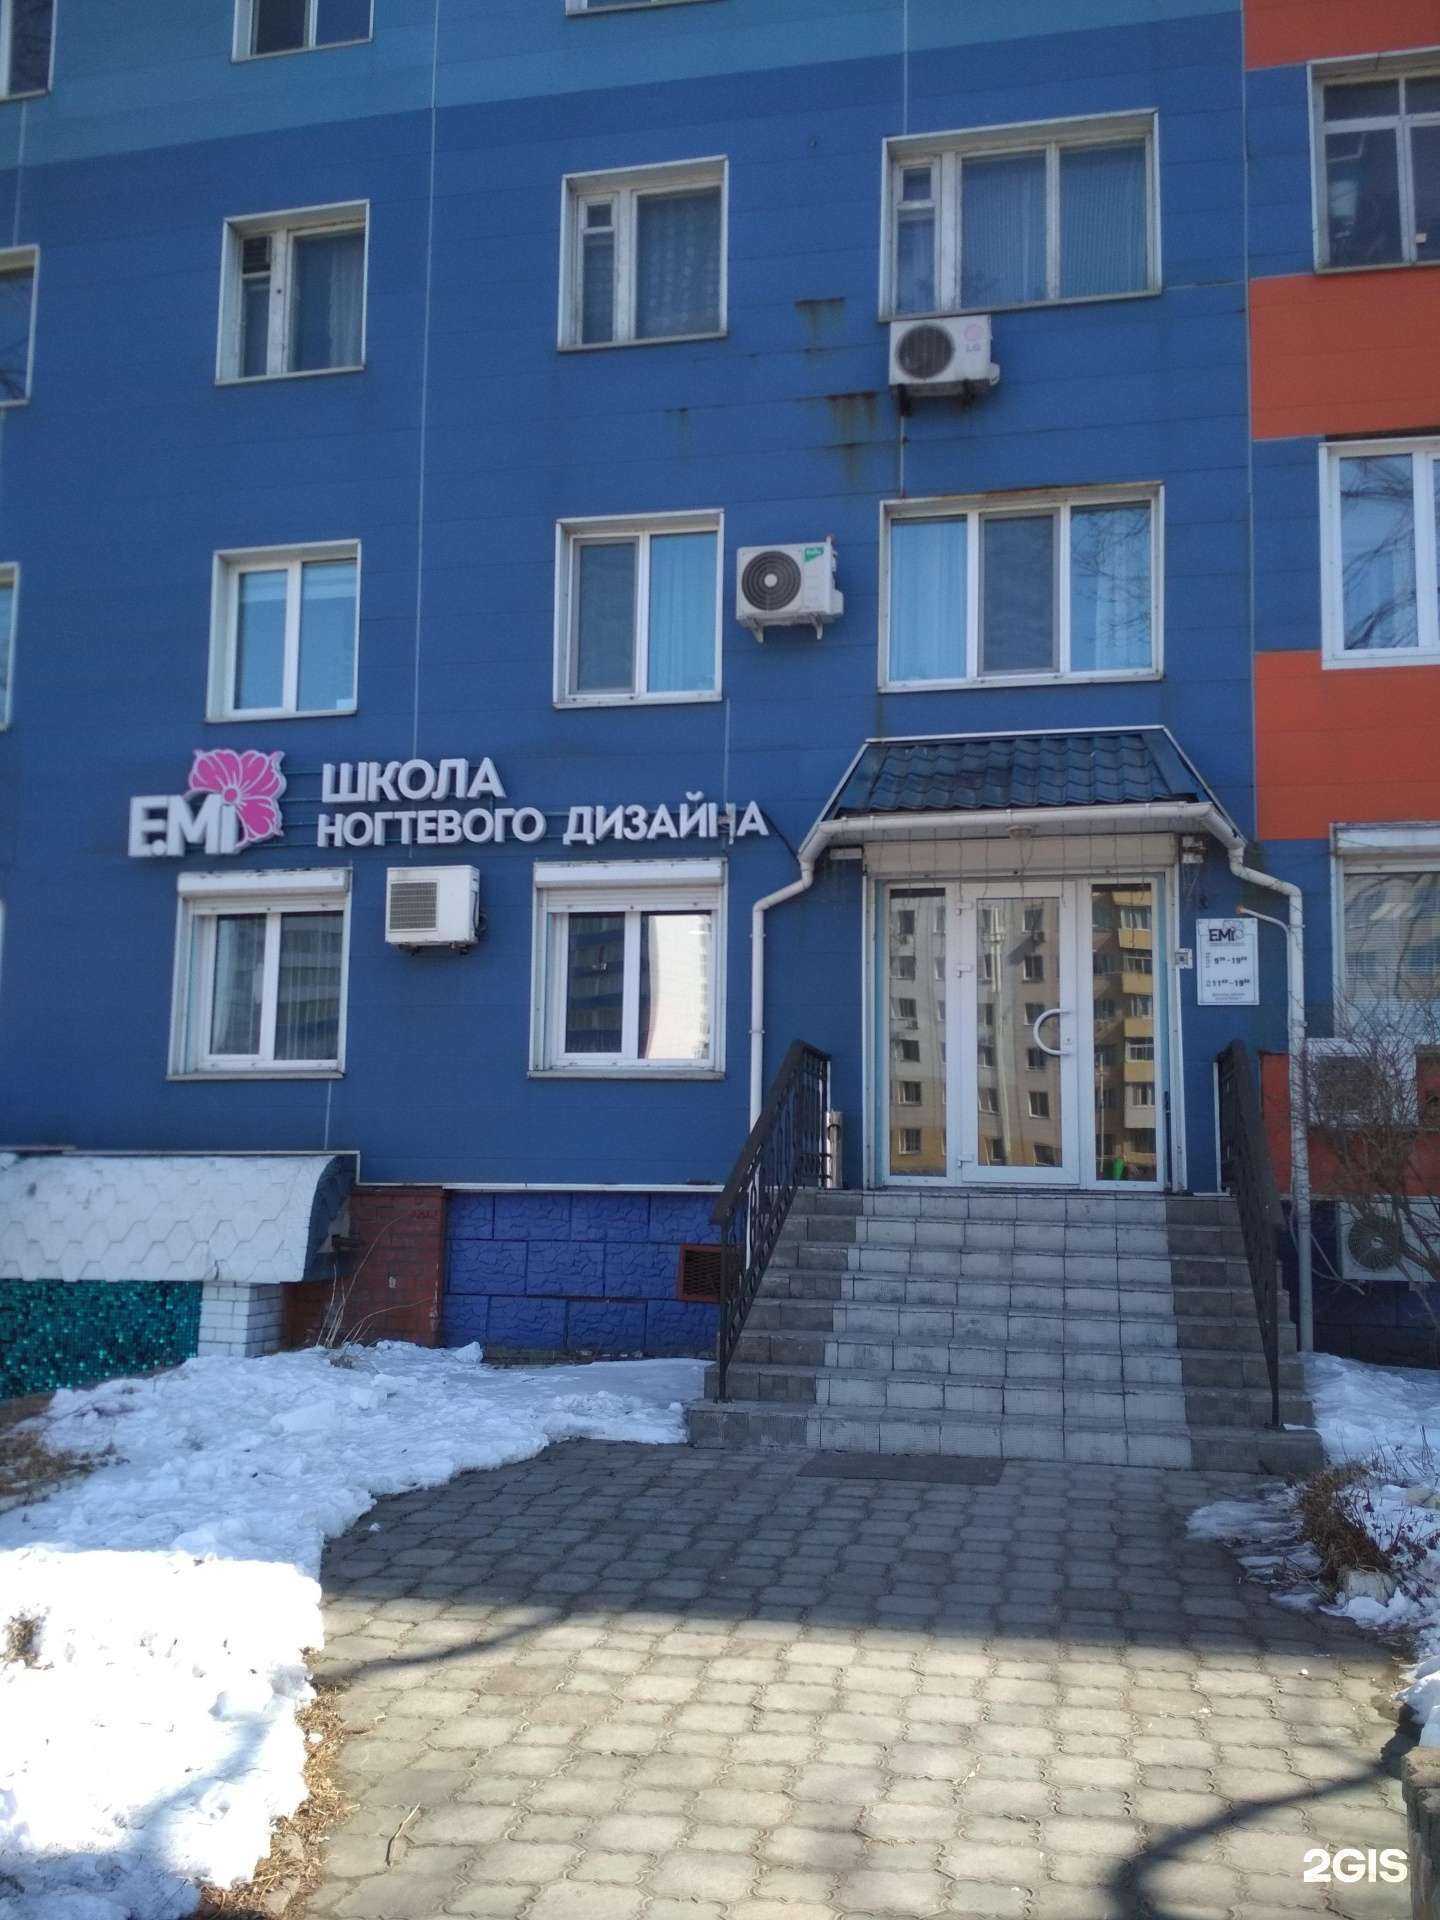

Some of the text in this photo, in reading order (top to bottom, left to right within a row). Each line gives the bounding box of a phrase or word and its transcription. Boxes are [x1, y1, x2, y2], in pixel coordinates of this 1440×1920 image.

[321, 757, 506, 803] ШКОЛА
[317, 790, 769, 848] НОГТЕВОГО ДИЗАЙНА
